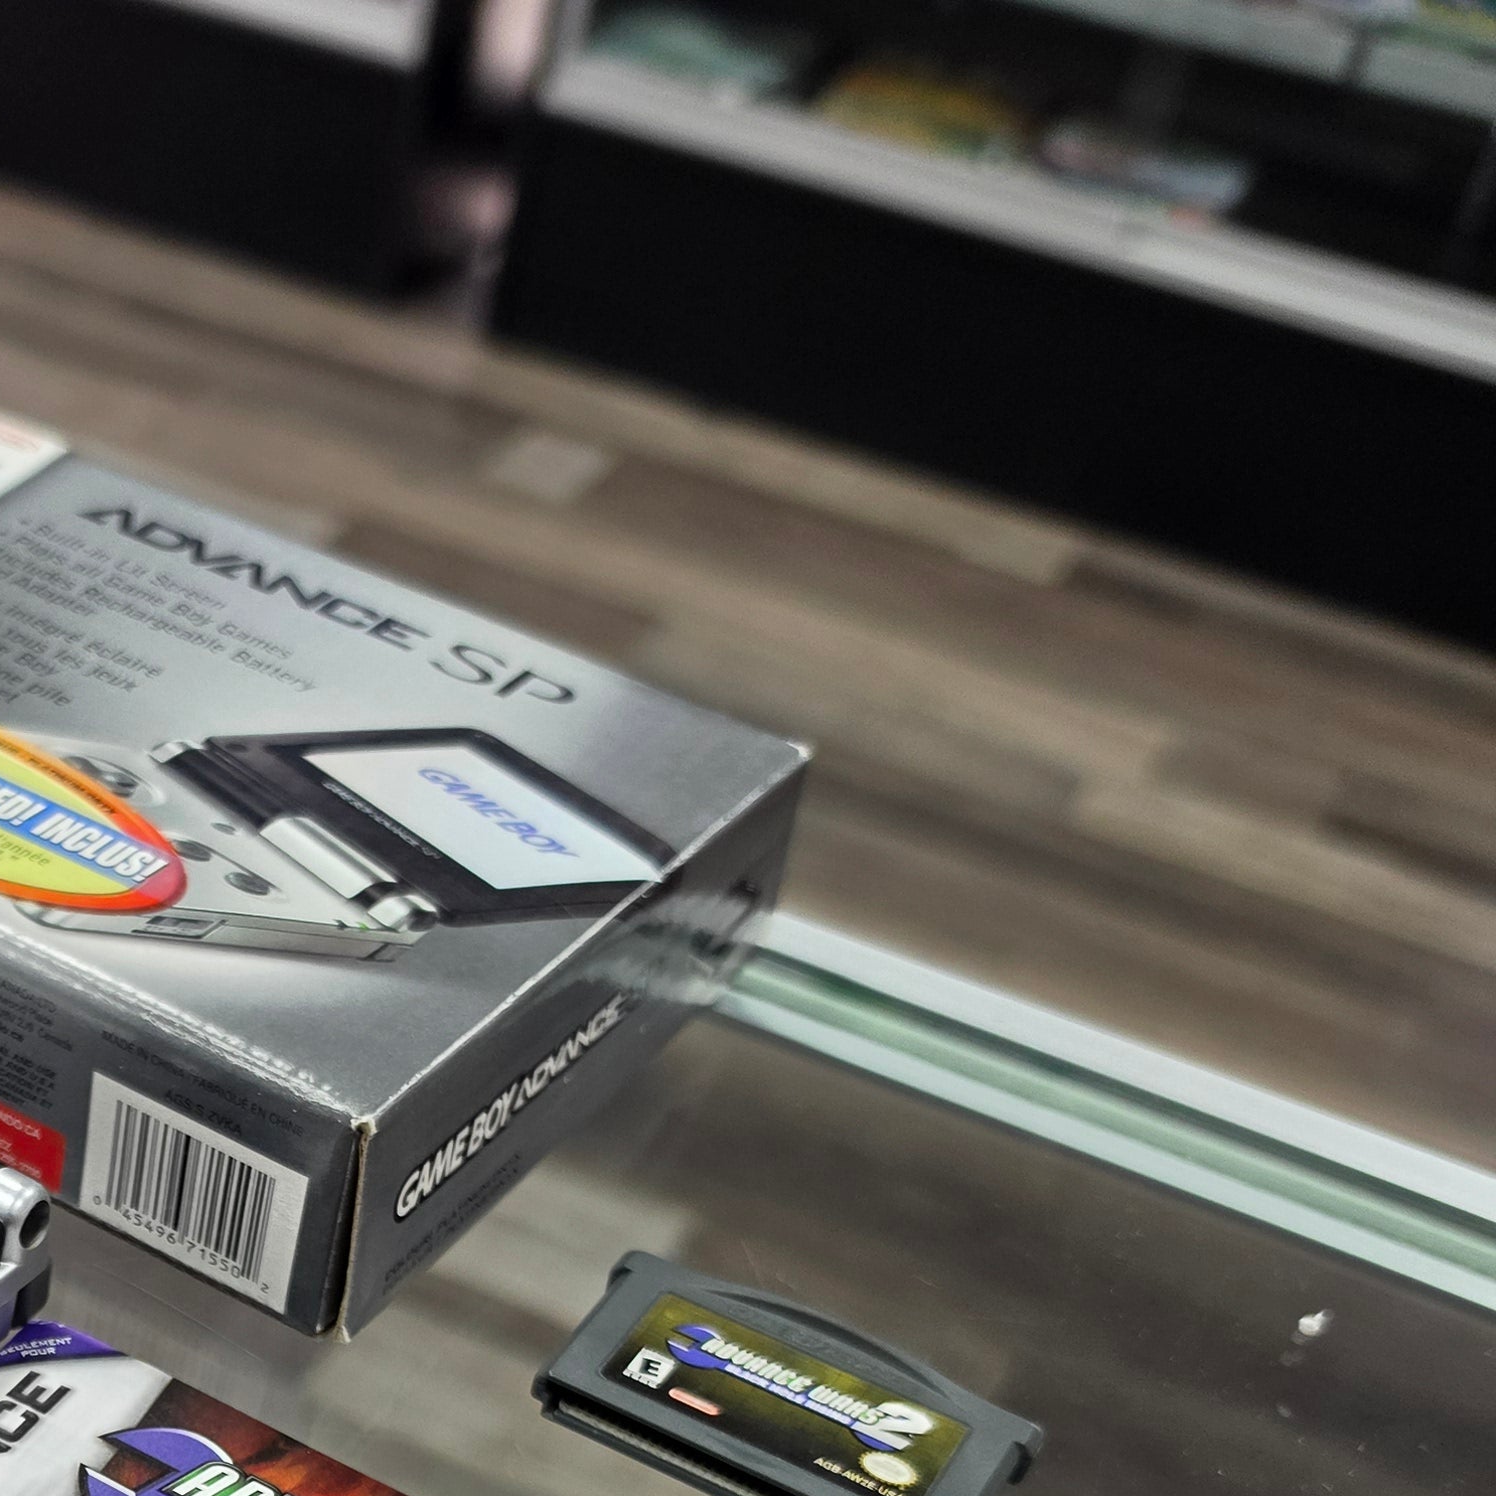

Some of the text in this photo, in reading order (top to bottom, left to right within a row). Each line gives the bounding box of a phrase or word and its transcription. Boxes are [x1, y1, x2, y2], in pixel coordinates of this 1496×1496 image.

[78, 508, 575, 706] ADVANCE SP
[83, 585, 225, 655] Rechargeable
[229, 650, 318, 693] Battery
[218, 622, 294, 661] Games
[24, 683, 73, 708] pile
[418, 768, 580, 858] GAME BOY
[29, 812, 170, 883] INCLUS!
[396, 992, 629, 1217] GAME BOY ADVANCE
[122, 1211, 177, 1246] 45496
[0, 1337, 73, 1356] SEULEMENT
[21, 1346, 58, 1359] POUR
[851, 1401, 935, 1451] 2
